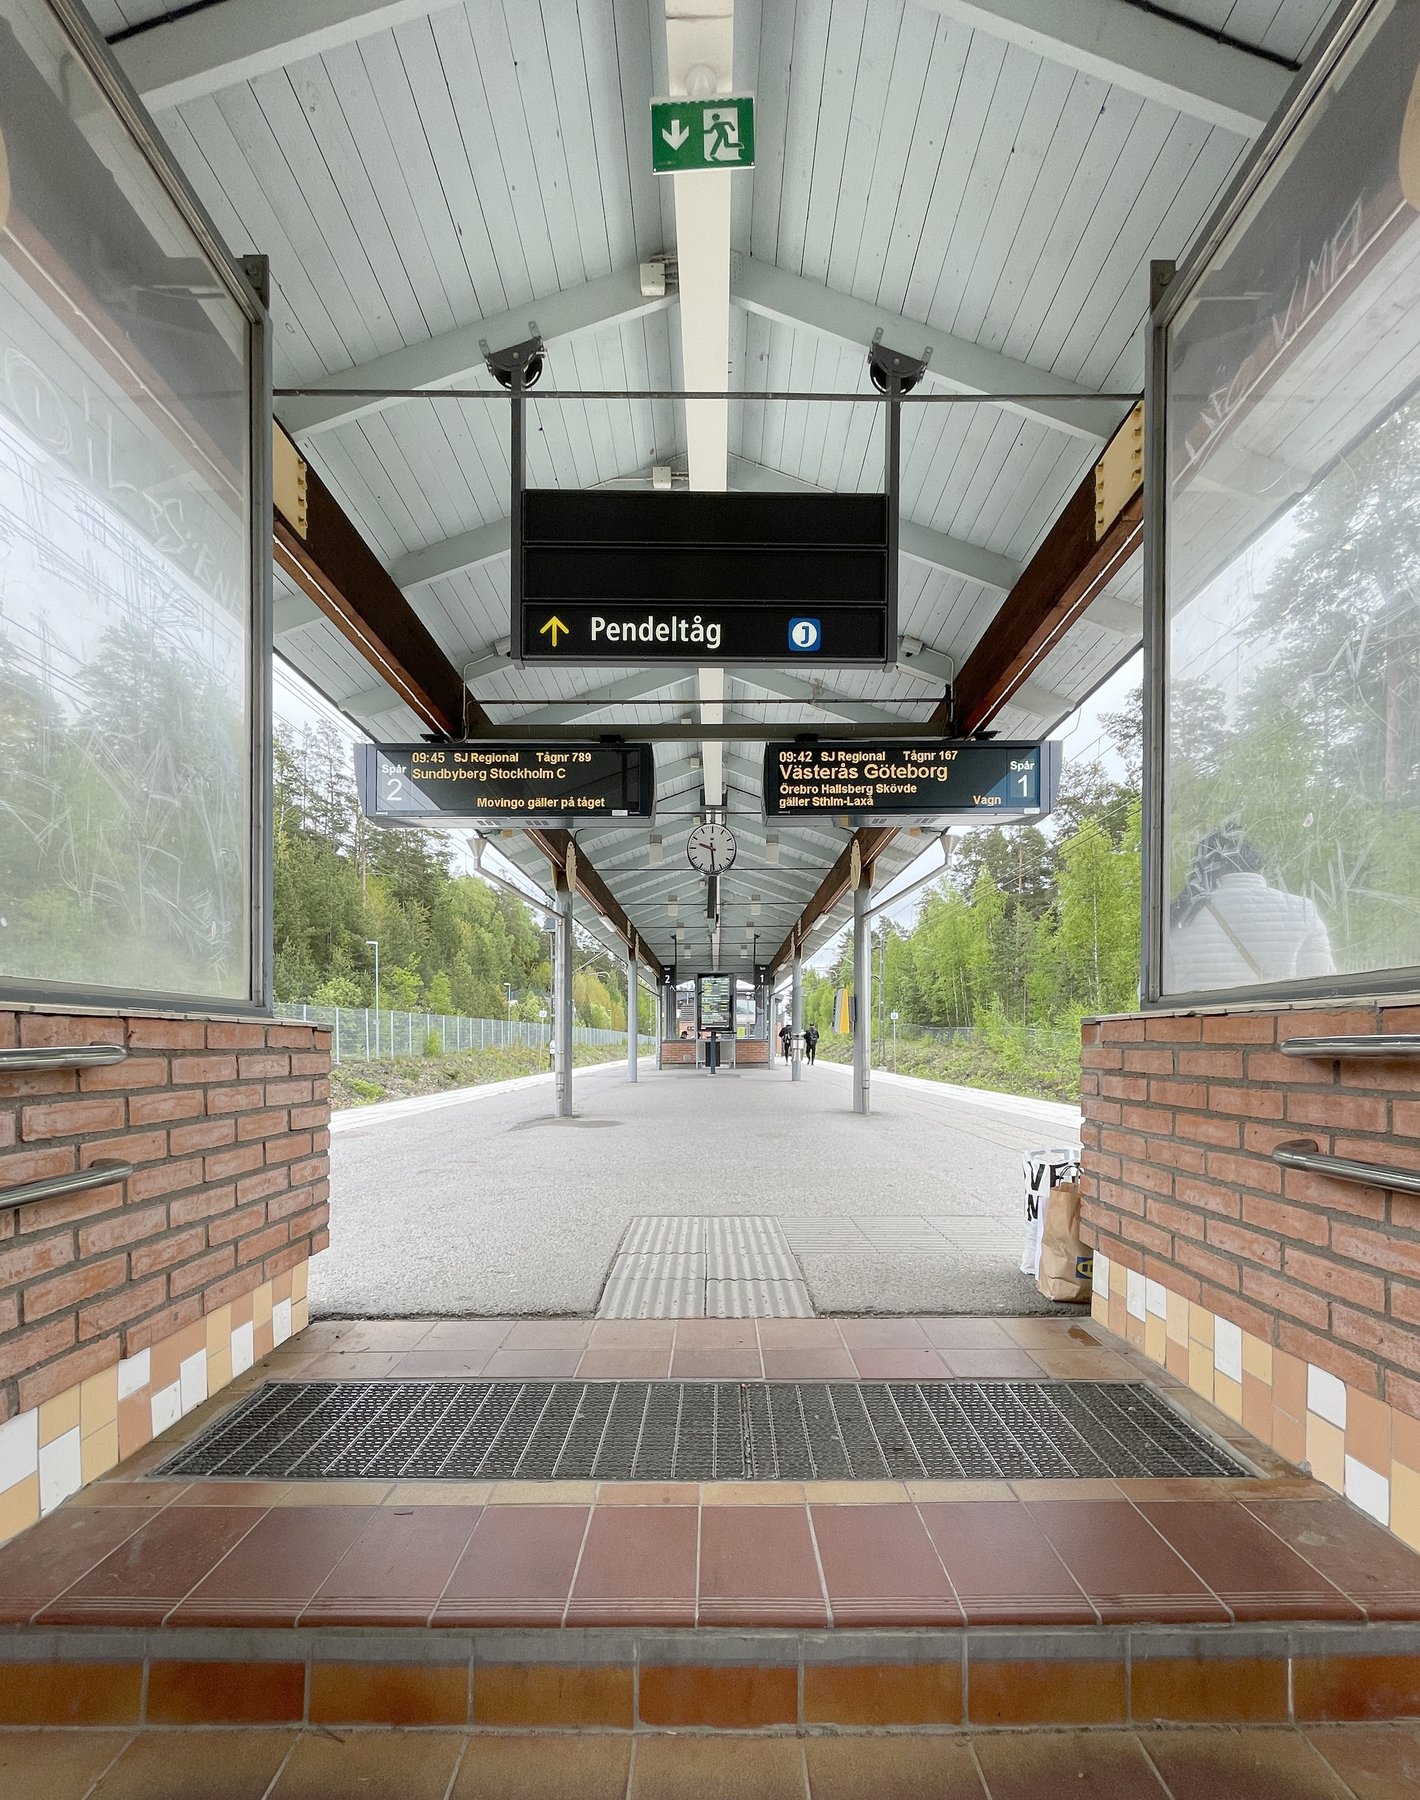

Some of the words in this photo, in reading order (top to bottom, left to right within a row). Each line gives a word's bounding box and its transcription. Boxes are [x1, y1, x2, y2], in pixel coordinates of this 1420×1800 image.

[591, 615, 721, 648] Pendeltåg
[412, 752, 445, 763] 09:45
[453, 752, 468, 763] SJ
[470, 752, 519, 764] Regional
[536, 752, 569, 764] Tågnr
[572, 752, 592, 763] 789
[779, 751, 813, 763] 09:42
[820, 751, 836, 762] SJ
[837, 751, 886, 763] Regional
[903, 750, 936, 762] Tågnr
[939, 750, 958, 761] 167
[381, 763, 407, 775] Spår
[779, 763, 859, 780] Västerås
[864, 763, 948, 782] Göteborg
[1010, 760, 1035, 772] Spår
[412, 767, 487, 781] Sundbyberg
[489, 767, 554, 779] Stockholm
[556, 767, 566, 779] C
[386, 778, 403, 801] 2
[779, 783, 819, 795] Örebro
[821, 783, 873, 796] Hallsberg
[876, 783, 918, 794] Skövde
[1018, 774, 1028, 798] 1
[477, 797, 525, 808] Movingo
[527, 797, 558, 810] gäller
[561, 797, 575, 810] på
[577, 797, 606, 810] tåget
[779, 797, 810, 809] gäller
[812, 795, 874, 807] Sthlm-Laxå
[972, 795, 1002, 807] Vagn
[664, 974, 671, 984] 2
[760, 974, 765, 983] 1
